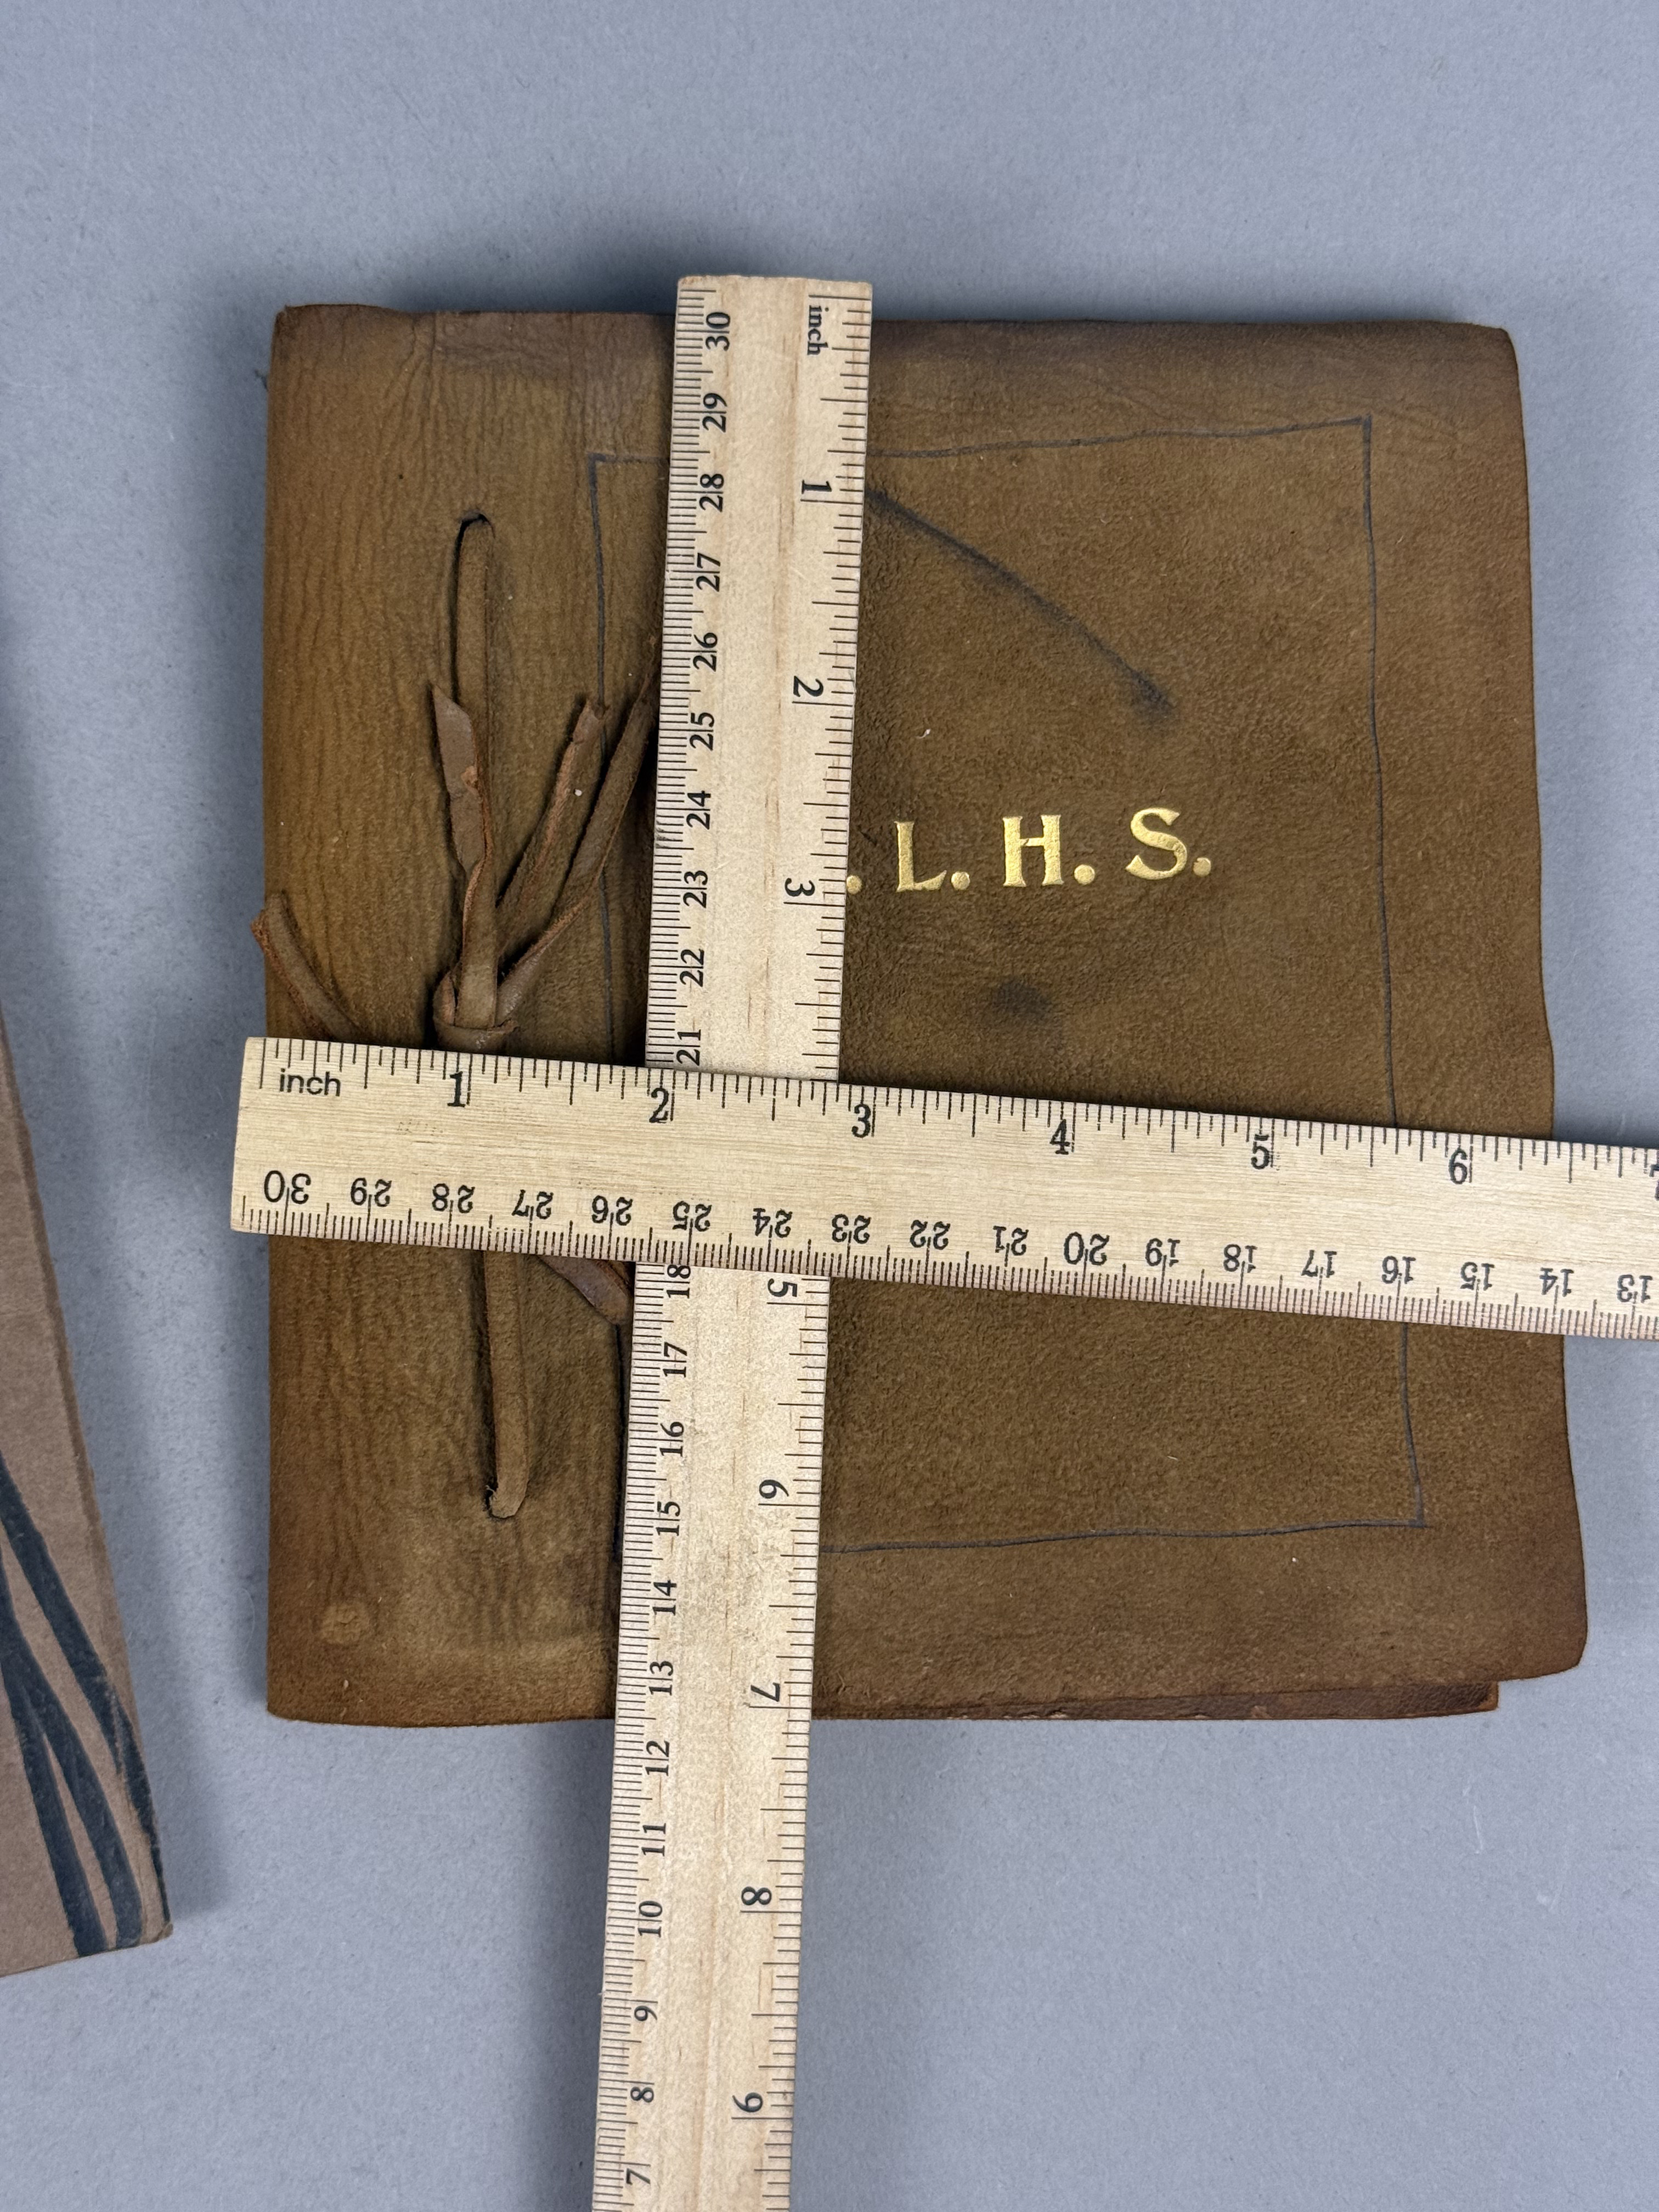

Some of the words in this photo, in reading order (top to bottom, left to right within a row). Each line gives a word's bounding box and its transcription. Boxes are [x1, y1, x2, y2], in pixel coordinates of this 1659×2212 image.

[706, 312, 730, 351] 30
[807, 304, 829, 356] inch
[703, 393, 728, 432] 29
[699, 473, 724, 512] 28
[802, 480, 832, 493] 1
[696, 552, 721, 592] 27
[693, 633, 718, 672] 26
[793, 676, 823, 697] 2
[690, 712, 714, 751] 25
[687, 790, 710, 829] 24
[894, 821, 970, 892] L.
[1003, 815, 1095, 887] H.
[1126, 808, 1211, 879] S.
[684, 870, 708, 908] 23
[785, 878, 815, 897] 3
[680, 949, 705, 987] 22
[677, 1029, 701, 1066] 21
[279, 1068, 341, 1097] inch
[447, 1071, 465, 1107] 1
[649, 1087, 669, 1124] 2
[852, 1104, 871, 1138] 3
[1050, 1119, 1070, 1154] 4
[1251, 1133, 1269, 1169] 5
[1449, 1149, 1468, 1184] 6
[263, 1170, 311, 1204] 30
[351, 1177, 392, 1207] 29
[431, 1183, 475, 1213] 28
[512, 1189, 554, 1219] 27
[591, 1195, 633, 1226] 26
[673, 1201, 712, 1232] 25
[753, 1209, 793, 1238] 24
[832, 1214, 871, 1244] 23
[910, 1220, 950, 1250] 22
[993, 1226, 1029, 1255] 21
[1064, 1232, 1109, 1266] 20
[1146, 1238, 1180, 1267] 19
[1223, 1244, 1257, 1273] 18
[1301, 1250, 1337, 1278] 17
[1382, 1256, 1415, 1284] 16
[667, 1265, 691, 1299] 18
[768, 1278, 797, 1297] 5
[1460, 1262, 1494, 1290] 15
[1540, 1268, 1574, 1297] 14
[1617, 1274, 1652, 1303] 13
[663, 1342, 687, 1378] 17
[659, 1421, 684, 1457] 16
[759, 1480, 789, 1499] 6
[656, 1500, 680, 1536] 15
[652, 1580, 677, 1615] 14
[649, 1661, 673, 1696] 13
[750, 1683, 780, 1702] 7
[645, 1740, 670, 1776] 12
[641, 1822, 666, 1857] 11
[741, 1886, 772, 1905] 8
[637, 1900, 663, 1937] 10
[634, 2005, 657, 2022] 9
[630, 2086, 654, 2103] 8
[732, 2092, 763, 2112] 9
[626, 2169, 650, 2185] 7
